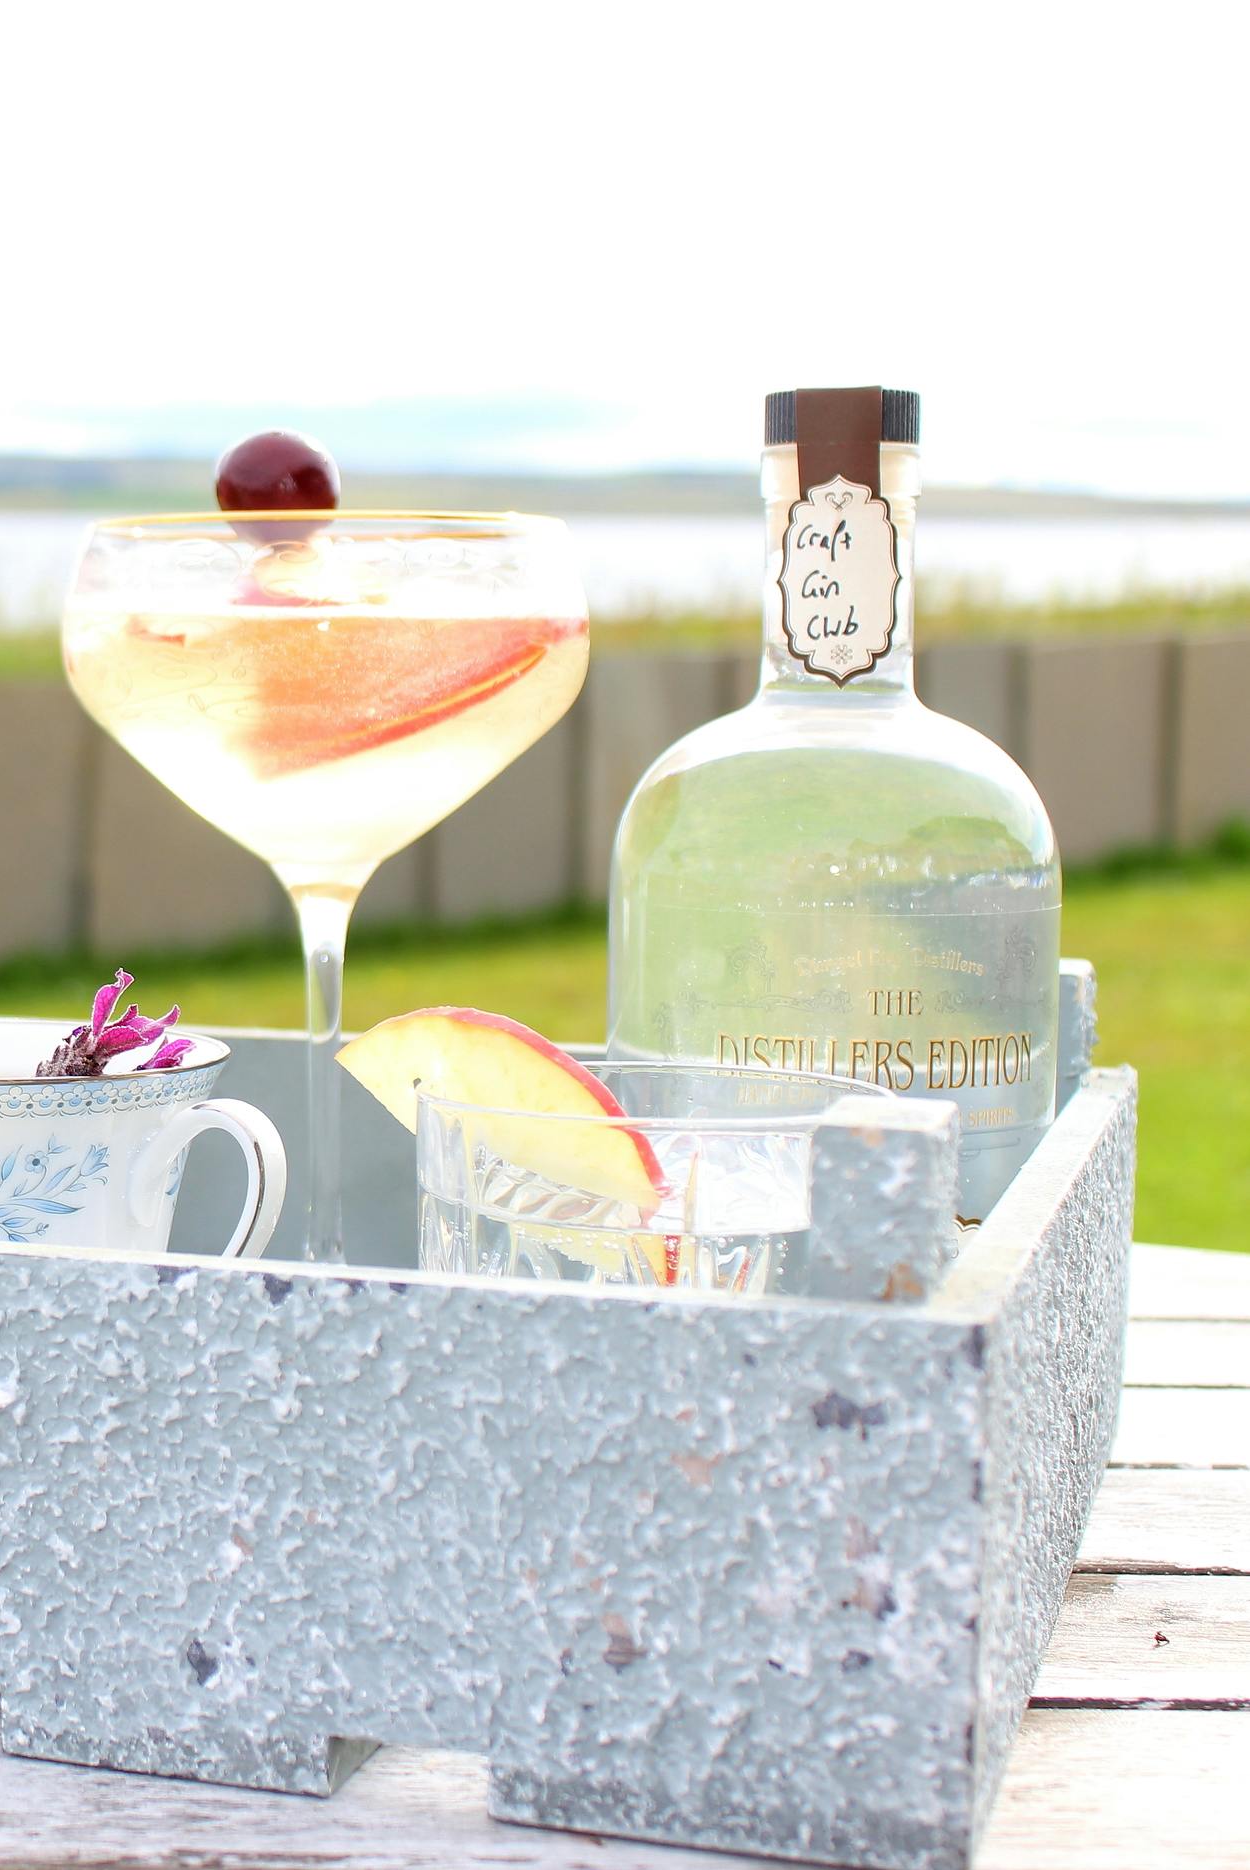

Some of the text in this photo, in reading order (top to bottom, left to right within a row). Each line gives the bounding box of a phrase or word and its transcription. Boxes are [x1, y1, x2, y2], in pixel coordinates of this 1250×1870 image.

[796, 519, 852, 562] Craft
[801, 569, 840, 600] Gin
[806, 604, 859, 641] Club
[909, 946, 986, 978] Distillers
[866, 988, 924, 1017] THE
[717, 1031, 1033, 1092] DISTILLERS EDITION
